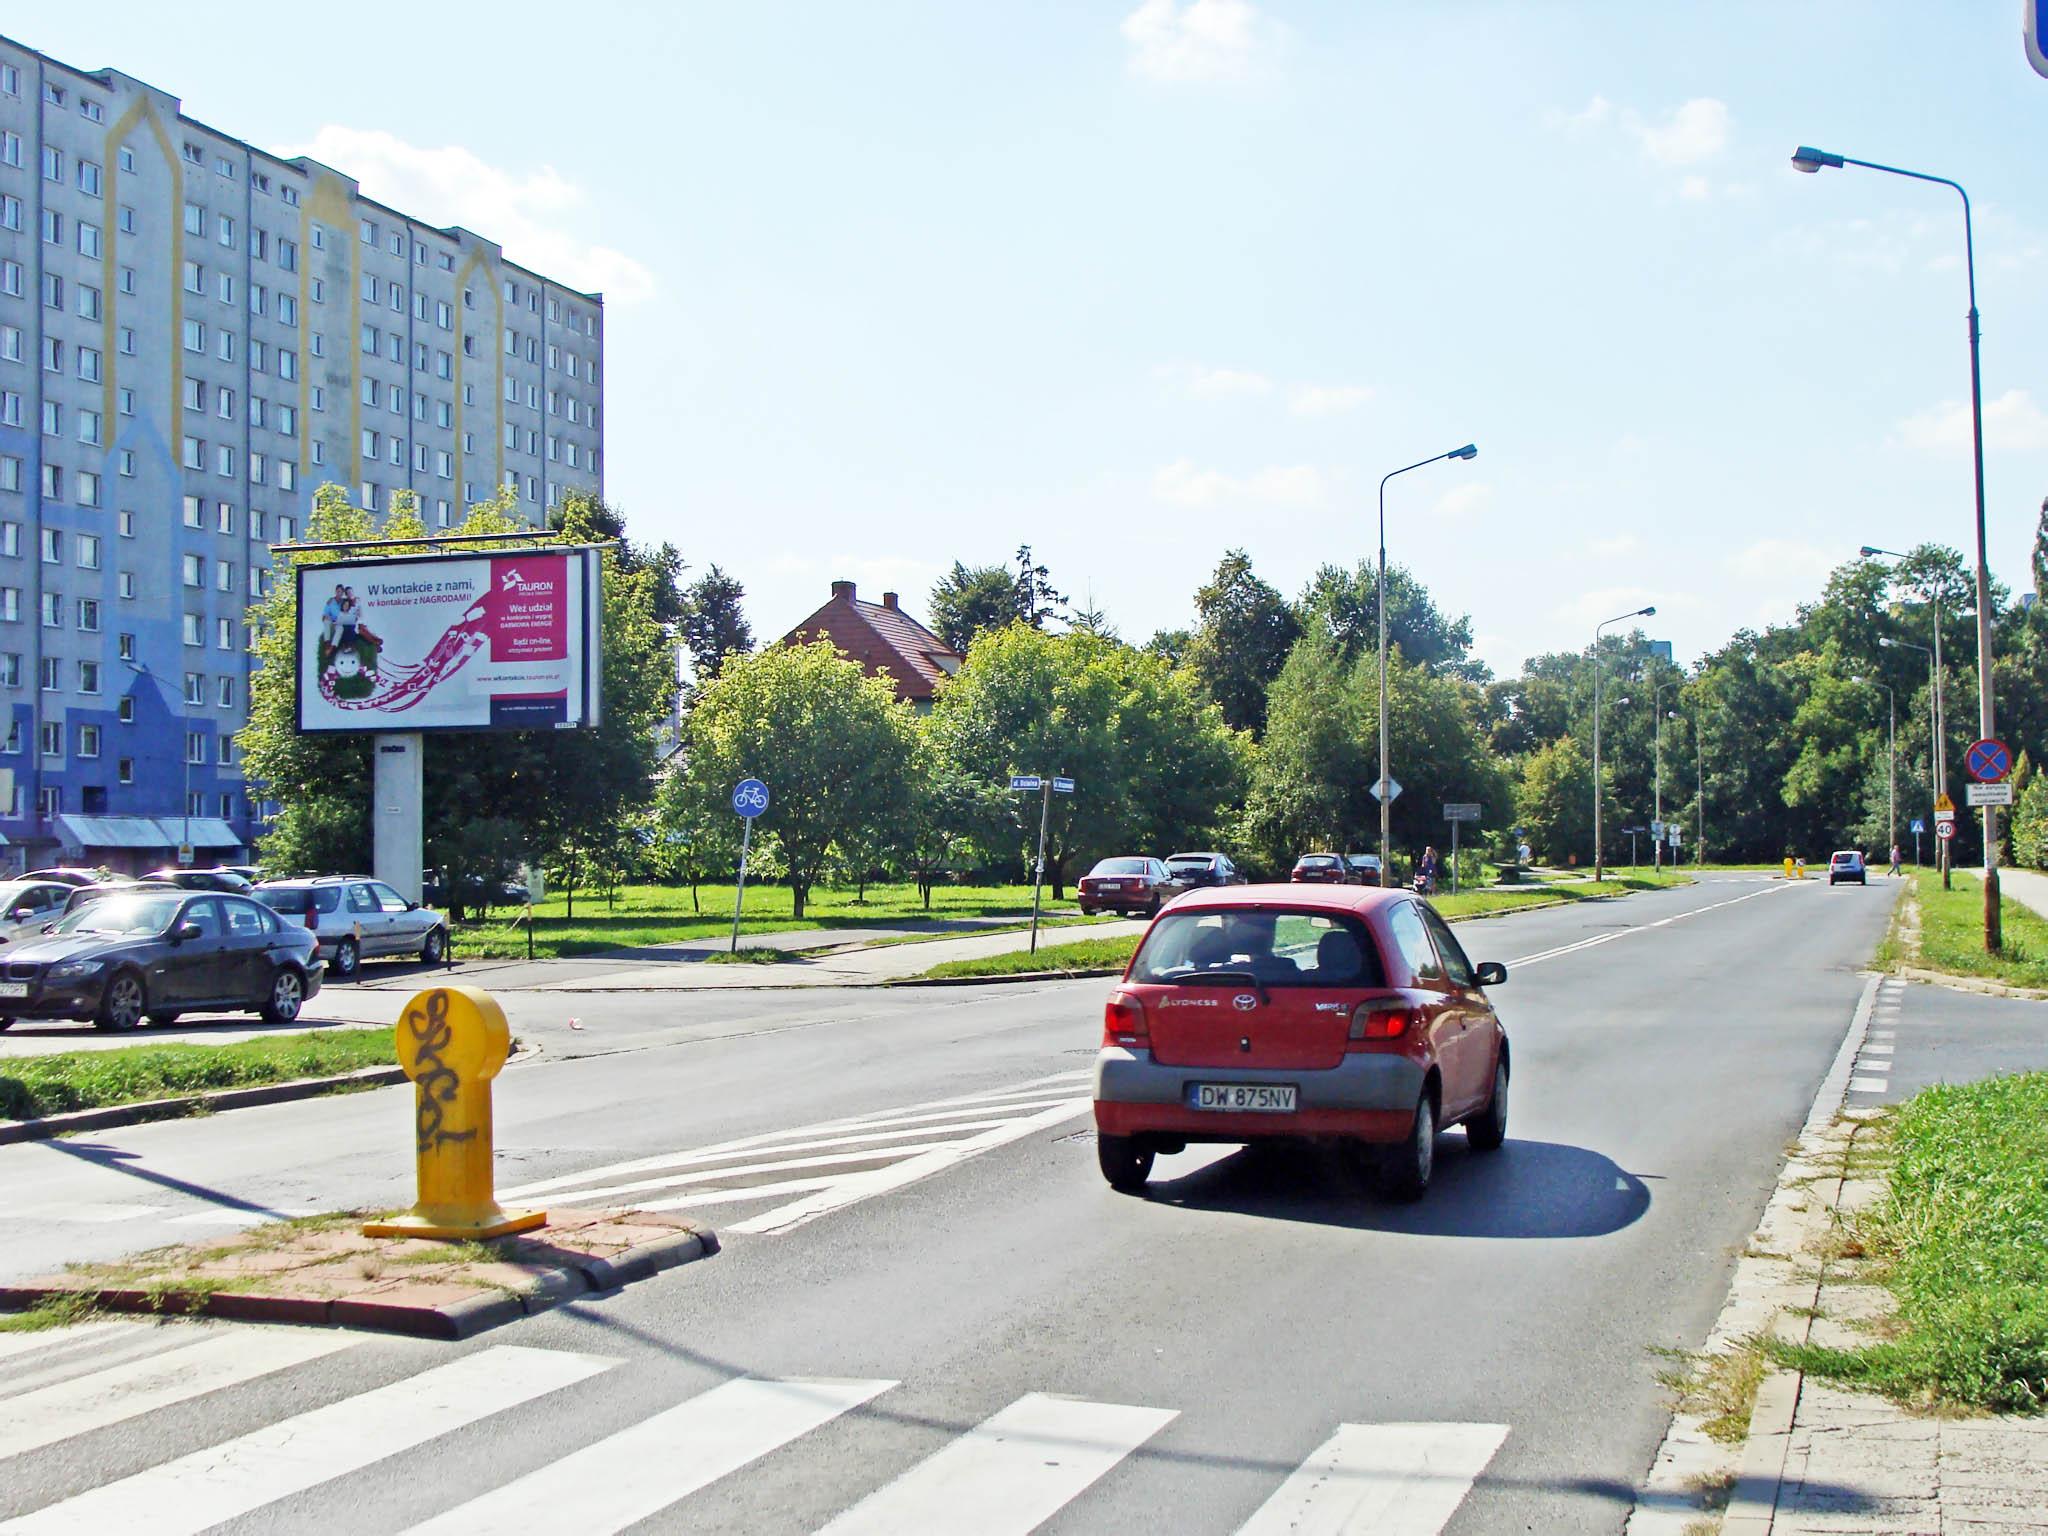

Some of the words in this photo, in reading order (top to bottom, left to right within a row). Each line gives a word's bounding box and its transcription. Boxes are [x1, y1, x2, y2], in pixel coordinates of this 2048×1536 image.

[368, 584, 379, 595] W
[382, 581, 433, 595] kontakcie
[436, 583, 442, 591] z
[445, 578, 475, 591] nami,
[518, 581, 553, 592] TAURON
[377, 597, 411, 607] kontakcie
[420, 593, 472, 604] NAGRODAMI!
[1938, 825, 1952, 834] 40
[1202, 1086, 1229, 1106] DW
[1235, 1087, 1293, 1108] 875NV
